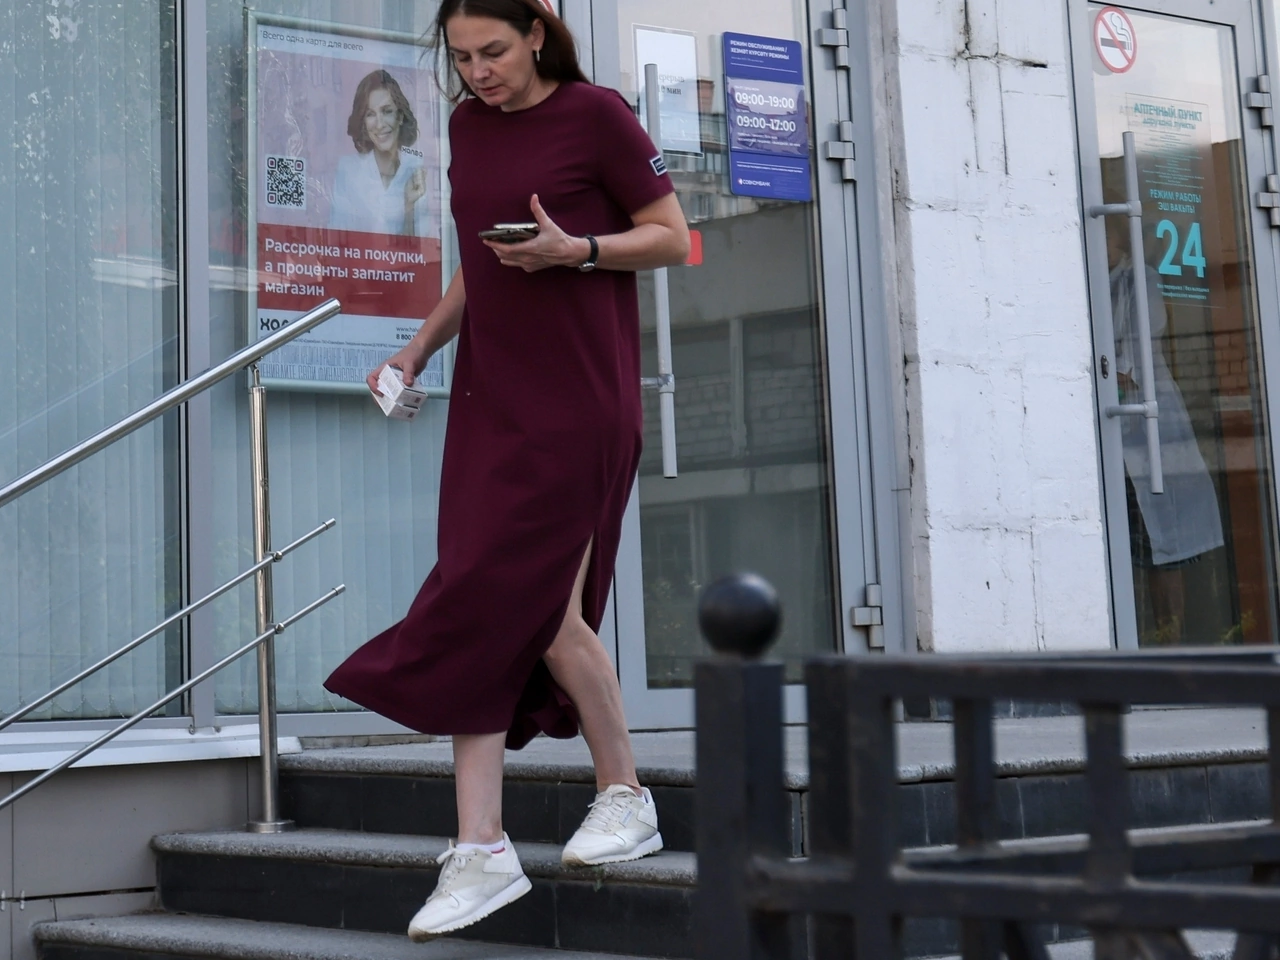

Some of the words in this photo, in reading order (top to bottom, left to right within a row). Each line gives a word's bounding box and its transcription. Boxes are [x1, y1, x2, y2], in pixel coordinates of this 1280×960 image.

[261, 31, 285, 42] Всего
[286, 35, 305, 44] одна
[305, 38, 327, 48] карта
[327, 41, 342, 49] для
[343, 43, 364, 52] всего
[1133, 102, 1176, 119] АПТЕЧНЫЙ
[1177, 108, 1203, 122] ПУНКТ
[1150, 188, 1174, 201] РЕЖИМ
[1175, 191, 1202, 204] РАБОТЫ
[265, 238, 341, 258] Рассрочка
[343, 247, 361, 259] на
[364, 249, 427, 267] покупки,
[1156, 219, 1207, 278] 24
[264, 261, 274, 273] а
[277, 261, 349, 279] проценты
[351, 268, 416, 283] заплатит
[265, 282, 325, 297] магазин
